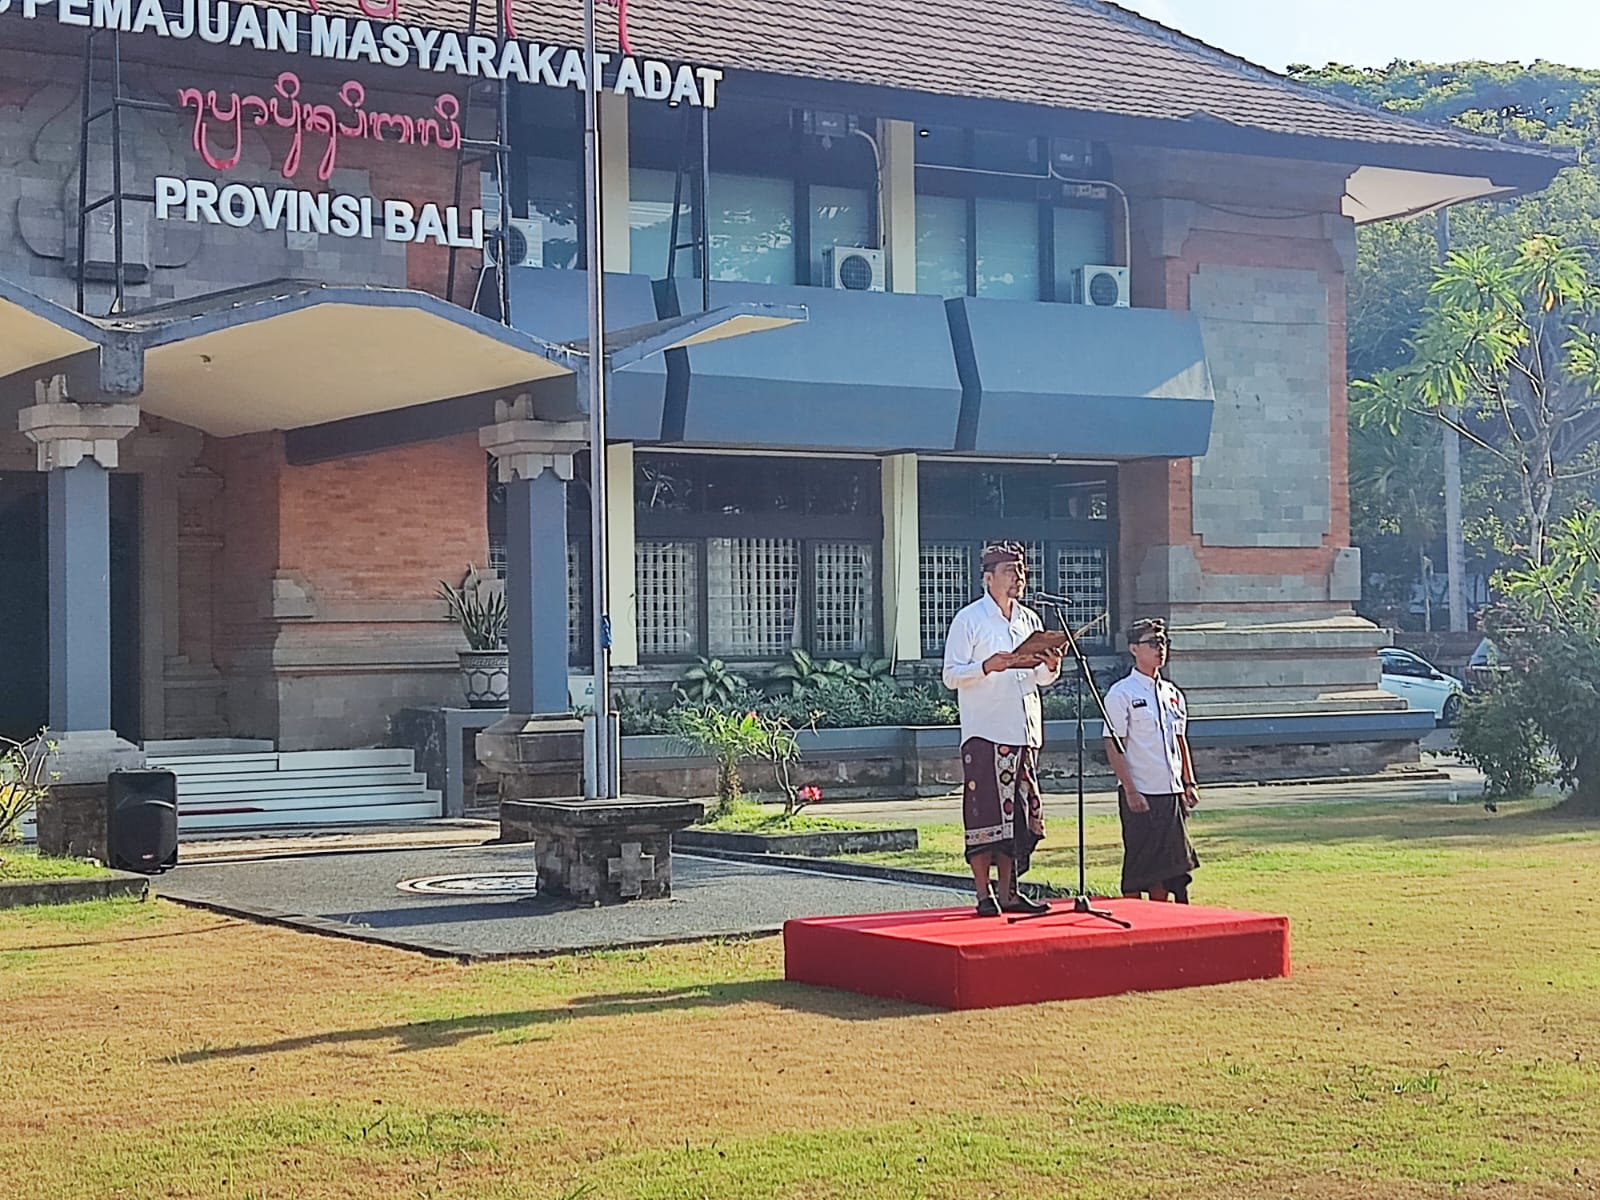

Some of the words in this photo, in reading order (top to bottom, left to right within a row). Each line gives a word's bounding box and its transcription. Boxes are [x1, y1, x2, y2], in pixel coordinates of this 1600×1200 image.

[310, 14, 610, 93] MASYARAKAT
[613, 57, 723, 108] ADAT
[155, 176, 374, 239] PROVINSI
[384, 200, 485, 250] BALI
